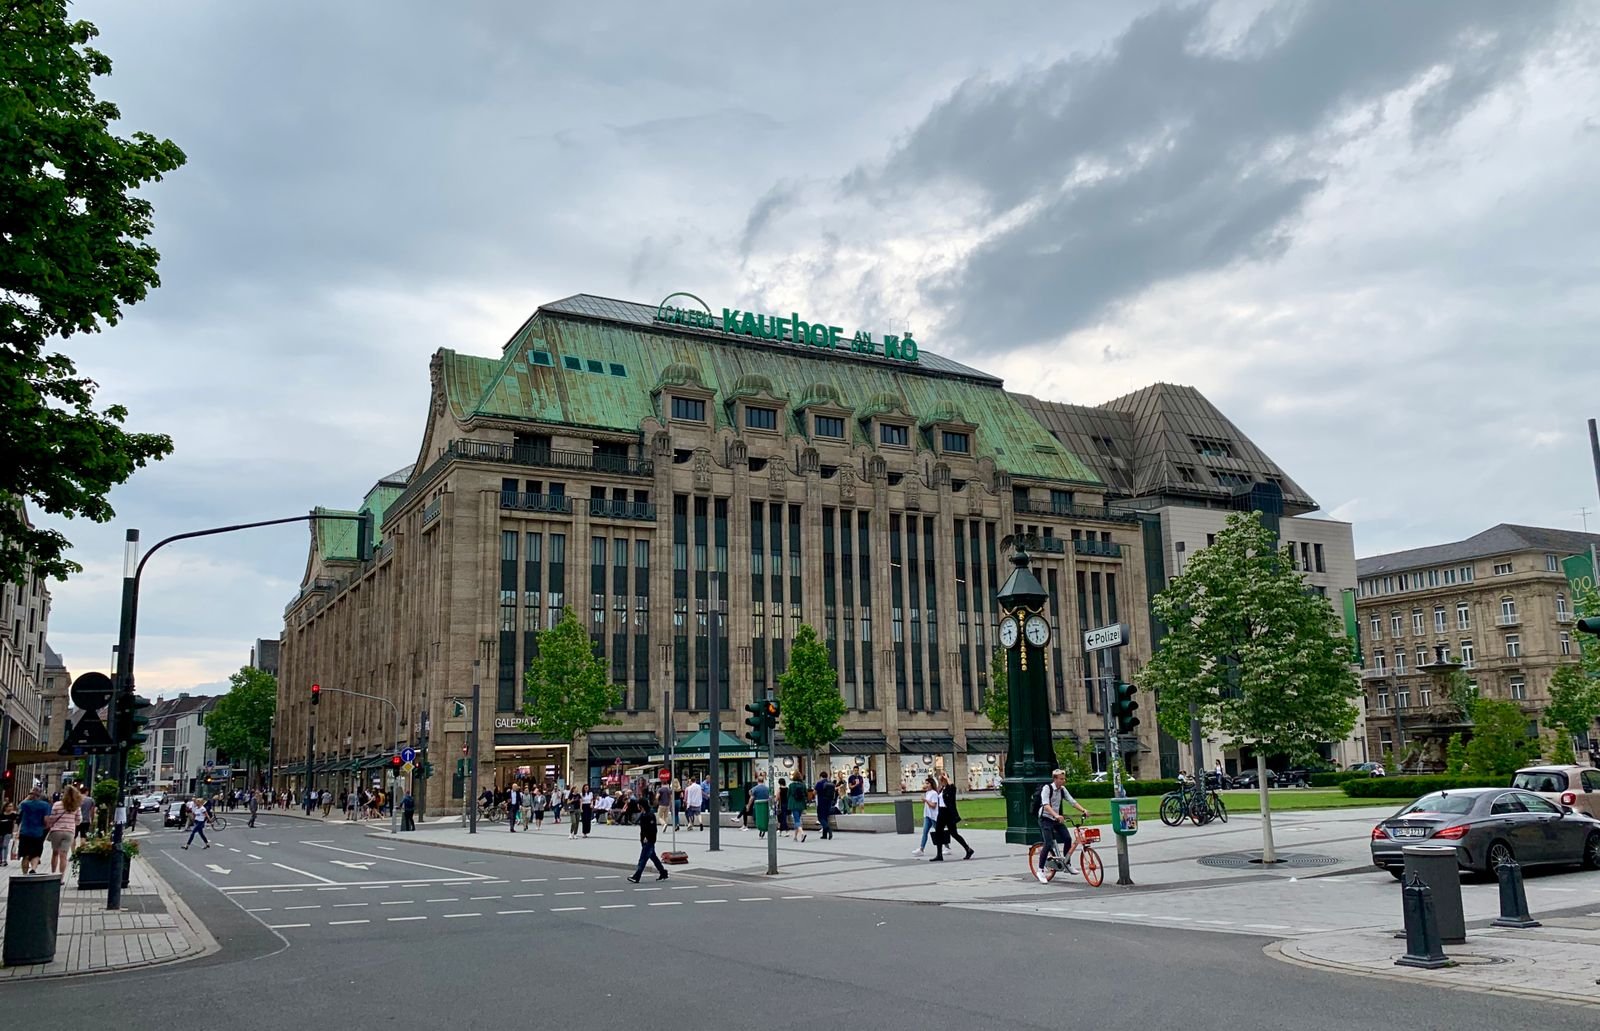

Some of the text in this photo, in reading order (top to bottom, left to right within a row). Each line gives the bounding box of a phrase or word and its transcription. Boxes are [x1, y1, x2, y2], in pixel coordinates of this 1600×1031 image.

[664, 305, 714, 329] GALERIA
[854, 330, 871, 342] AN
[851, 340, 875, 353] DER
[884, 331, 918, 360] KÖ
[1095, 628, 1120, 645] Polizei
